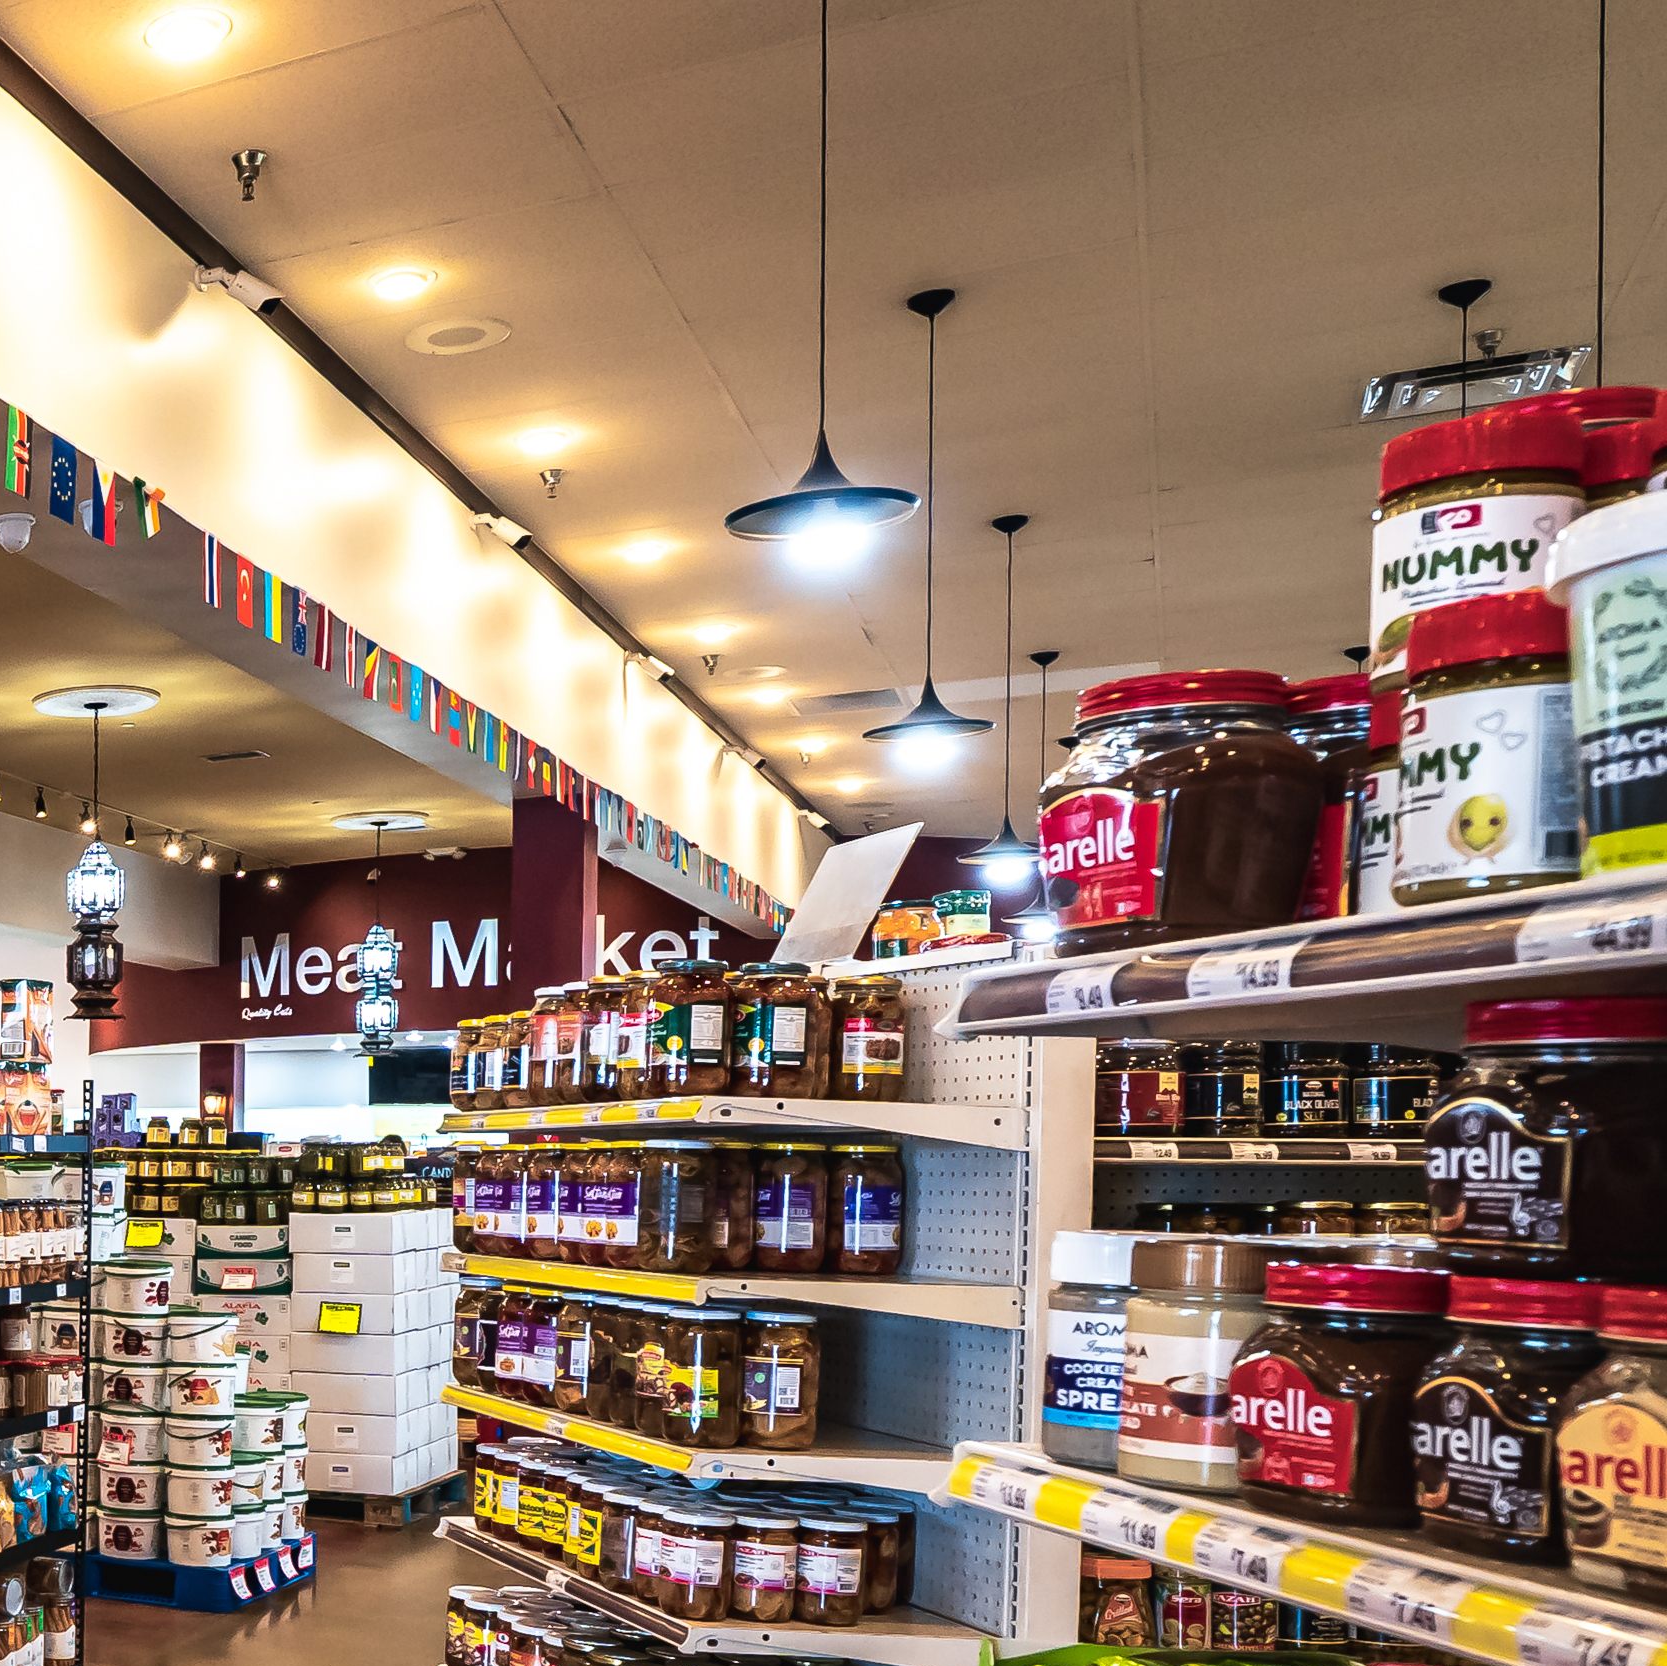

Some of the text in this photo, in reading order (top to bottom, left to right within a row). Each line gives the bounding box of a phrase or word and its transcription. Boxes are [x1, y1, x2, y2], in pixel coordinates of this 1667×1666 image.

[1381, 537, 1540, 593] NUMMY
[432, 915, 720, 989] Mket
[1427, 1140, 1543, 1181] arelle
[1230, 1390, 1333, 1436] arelle
[1412, 1416, 1523, 1471] arelle
